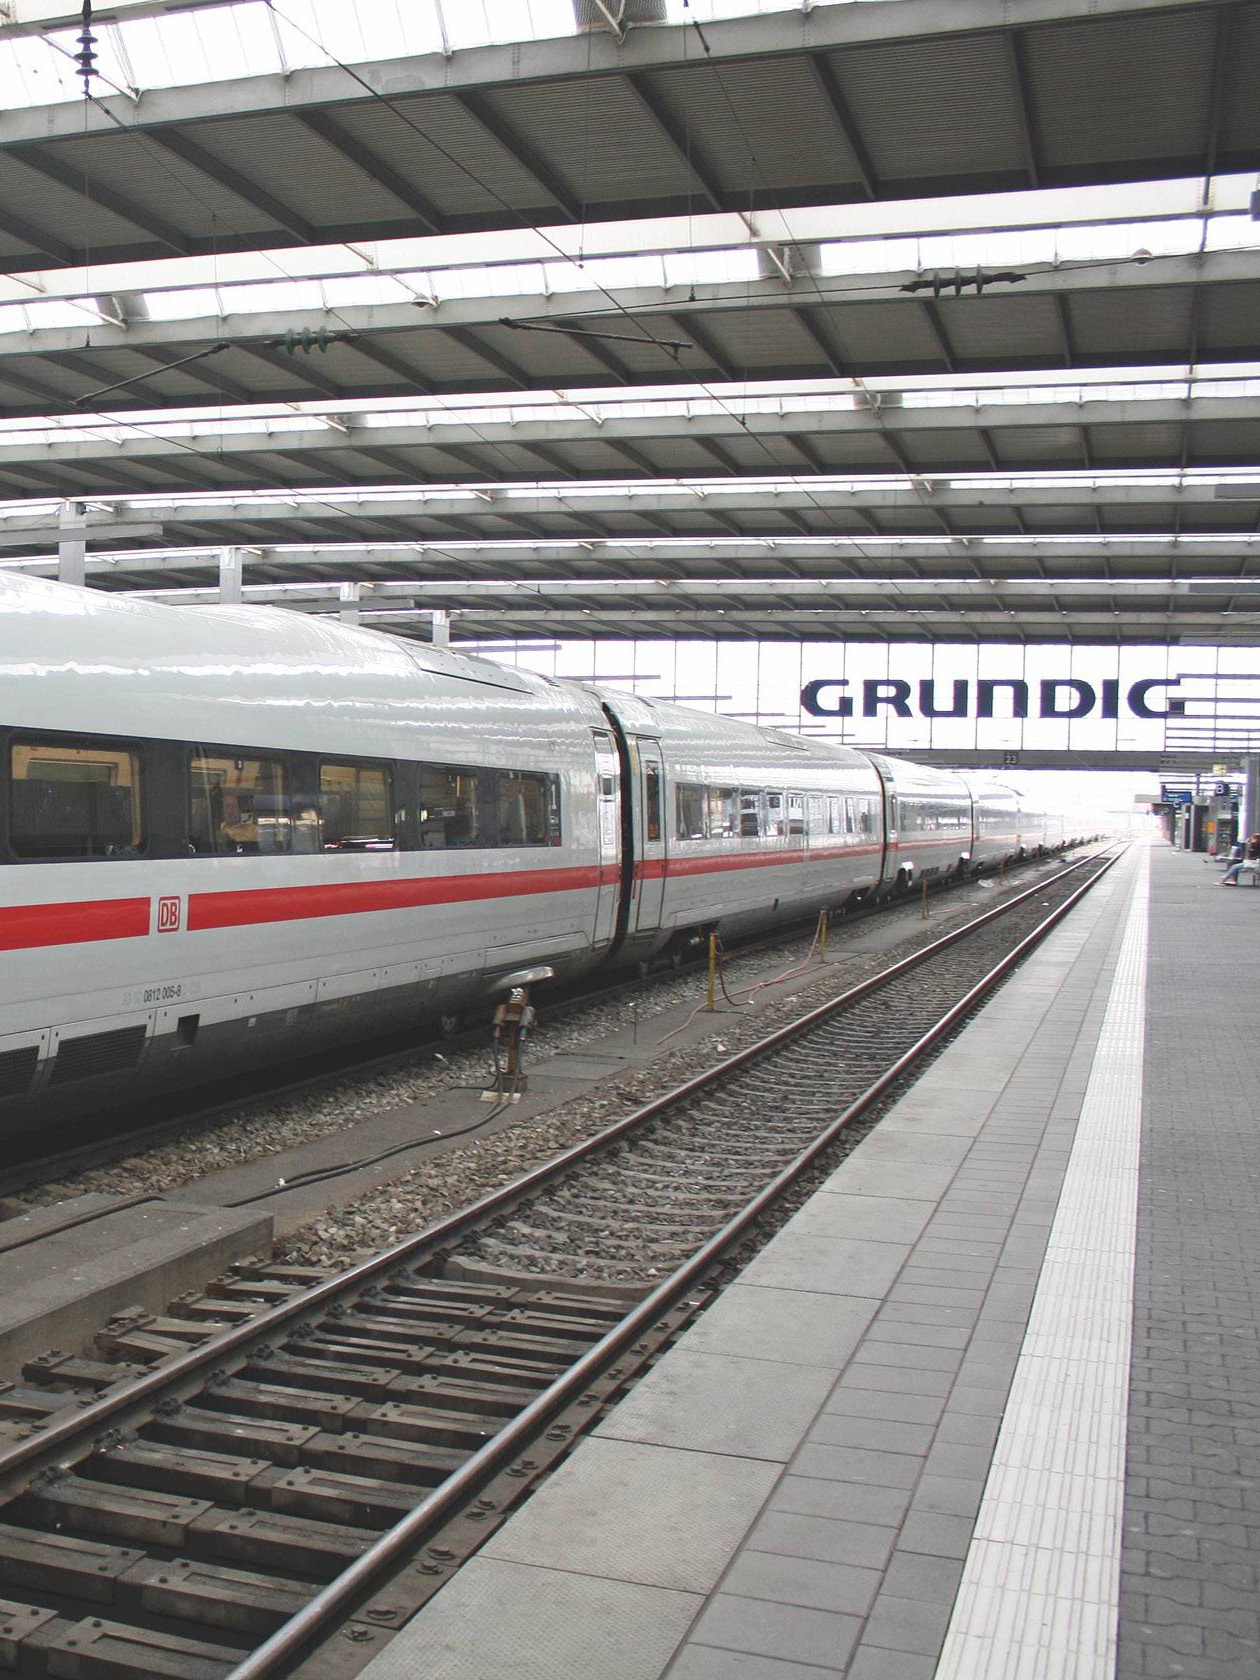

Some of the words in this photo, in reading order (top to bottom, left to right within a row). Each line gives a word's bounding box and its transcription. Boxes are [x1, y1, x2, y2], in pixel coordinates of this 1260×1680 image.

[800, 679, 1185, 718] GRUNDIG
[1005, 755, 1018, 764] 23
[160, 902, 178, 927] DB
[143, 987, 161, 1003] 0812
